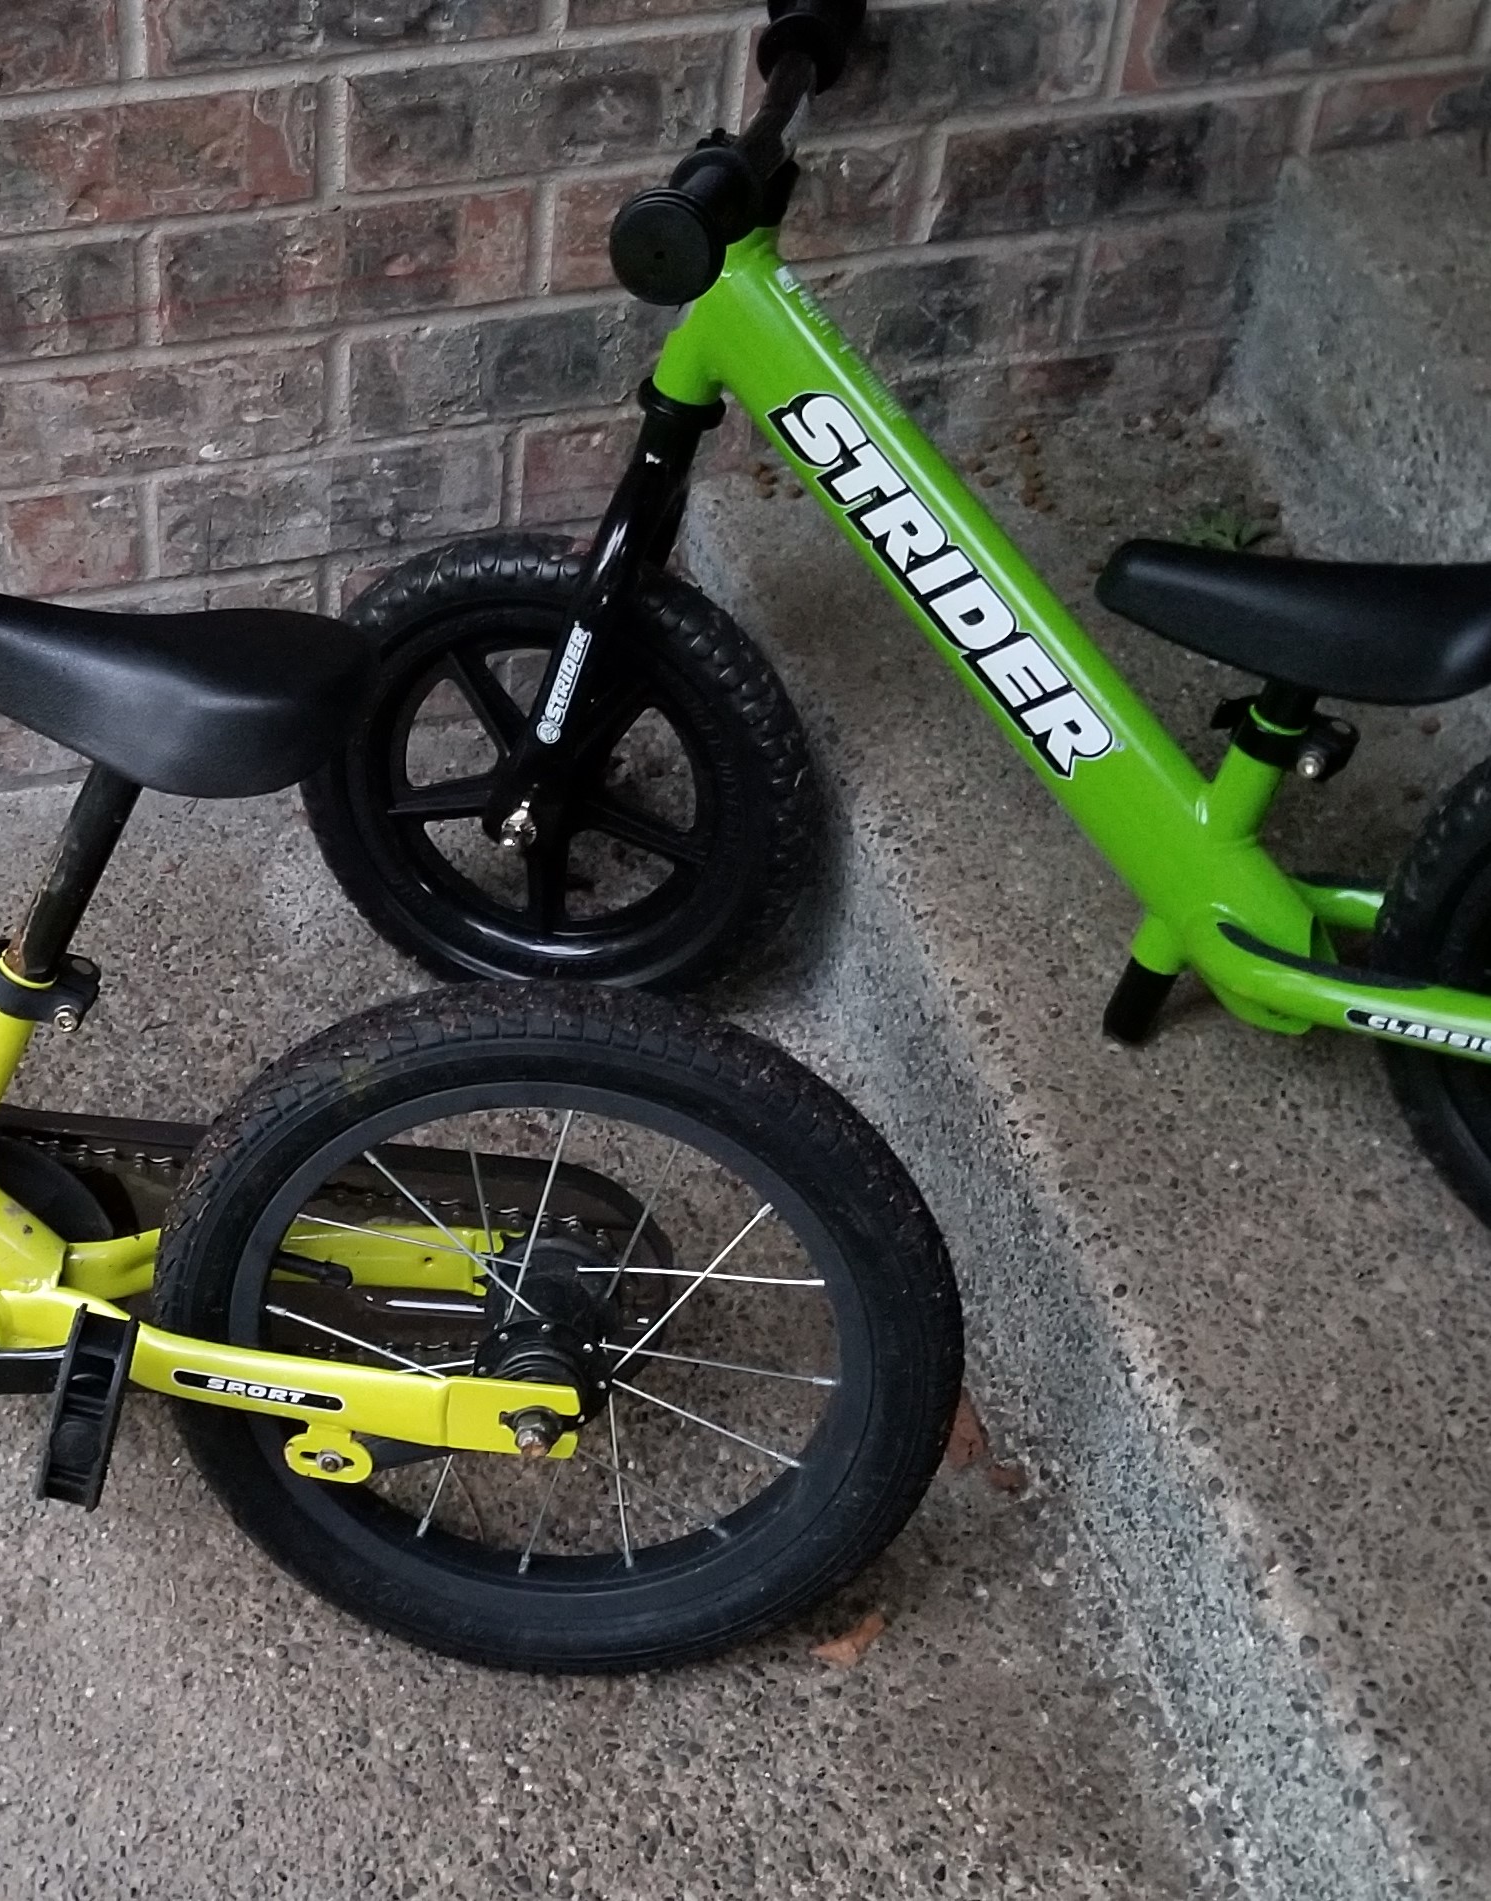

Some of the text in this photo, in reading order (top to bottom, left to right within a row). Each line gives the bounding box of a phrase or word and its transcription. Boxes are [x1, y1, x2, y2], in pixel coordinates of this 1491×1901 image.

[768, 393, 1113, 778] STRIDER
[545, 627, 592, 727] STRIDER
[206, 1377, 306, 1404] SPORT
